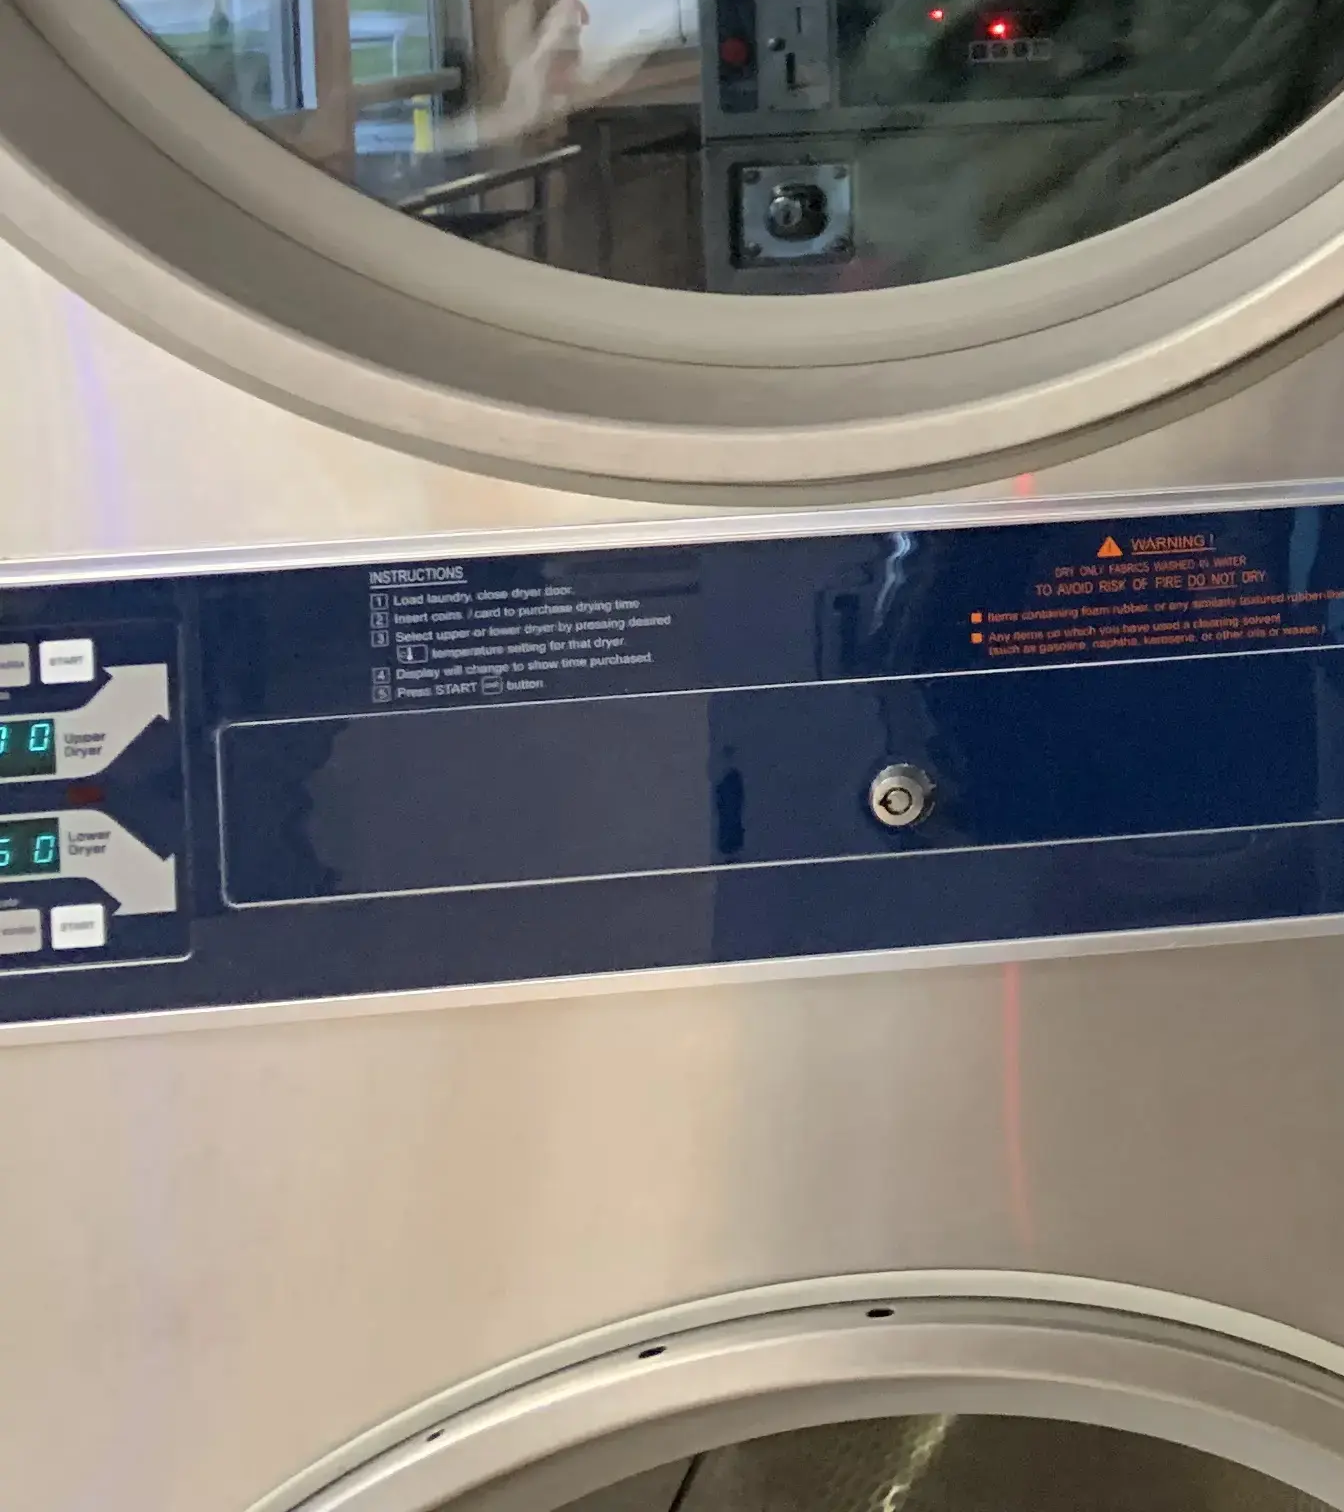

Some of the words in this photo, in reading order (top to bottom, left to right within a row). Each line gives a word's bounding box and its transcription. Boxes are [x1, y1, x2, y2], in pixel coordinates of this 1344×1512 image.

[1131, 534, 1205, 550] WARNING
[369, 566, 464, 584] INSTRUCTIONS
[1035, 584, 1053, 596] TO
[1057, 582, 1093, 595] AVOID
[1099, 579, 1126, 592] RISK
[1133, 578, 1148, 589] OF
[1155, 576, 1182, 588] FIRE
[1188, 574, 1206, 587] DO
[1211, 572, 1236, 584] NOT
[393, 595, 424, 606] Load
[476, 590, 508, 600] close
[511, 588, 541, 600] dryer
[504, 608, 515, 617] to
[518, 603, 573, 618] purchase
[576, 600, 612, 613] drying
[395, 631, 433, 642] Select
[436, 630, 470, 641] upper
[473, 628, 485, 637] or
[489, 625, 520, 636] lower
[524, 623, 554, 635] dryer
[558, 621, 573, 633] by
[575, 618, 624, 632] pressing
[628, 615, 672, 627] desired
[507, 641, 547, 654] setting
[550, 640, 565, 651] for
[568, 638, 591, 650] that
[443, 665, 463, 676] will
[465, 663, 509, 676] change
[513, 661, 524, 671] to
[528, 659, 558, 671] show
[561, 658, 587, 668] time
[435, 682, 478, 695] START
[64, 733, 106, 745] Upper
[64, 746, 103, 759] Dryer
[68, 830, 111, 842] Lower
[68, 845, 106, 857] Dryer
